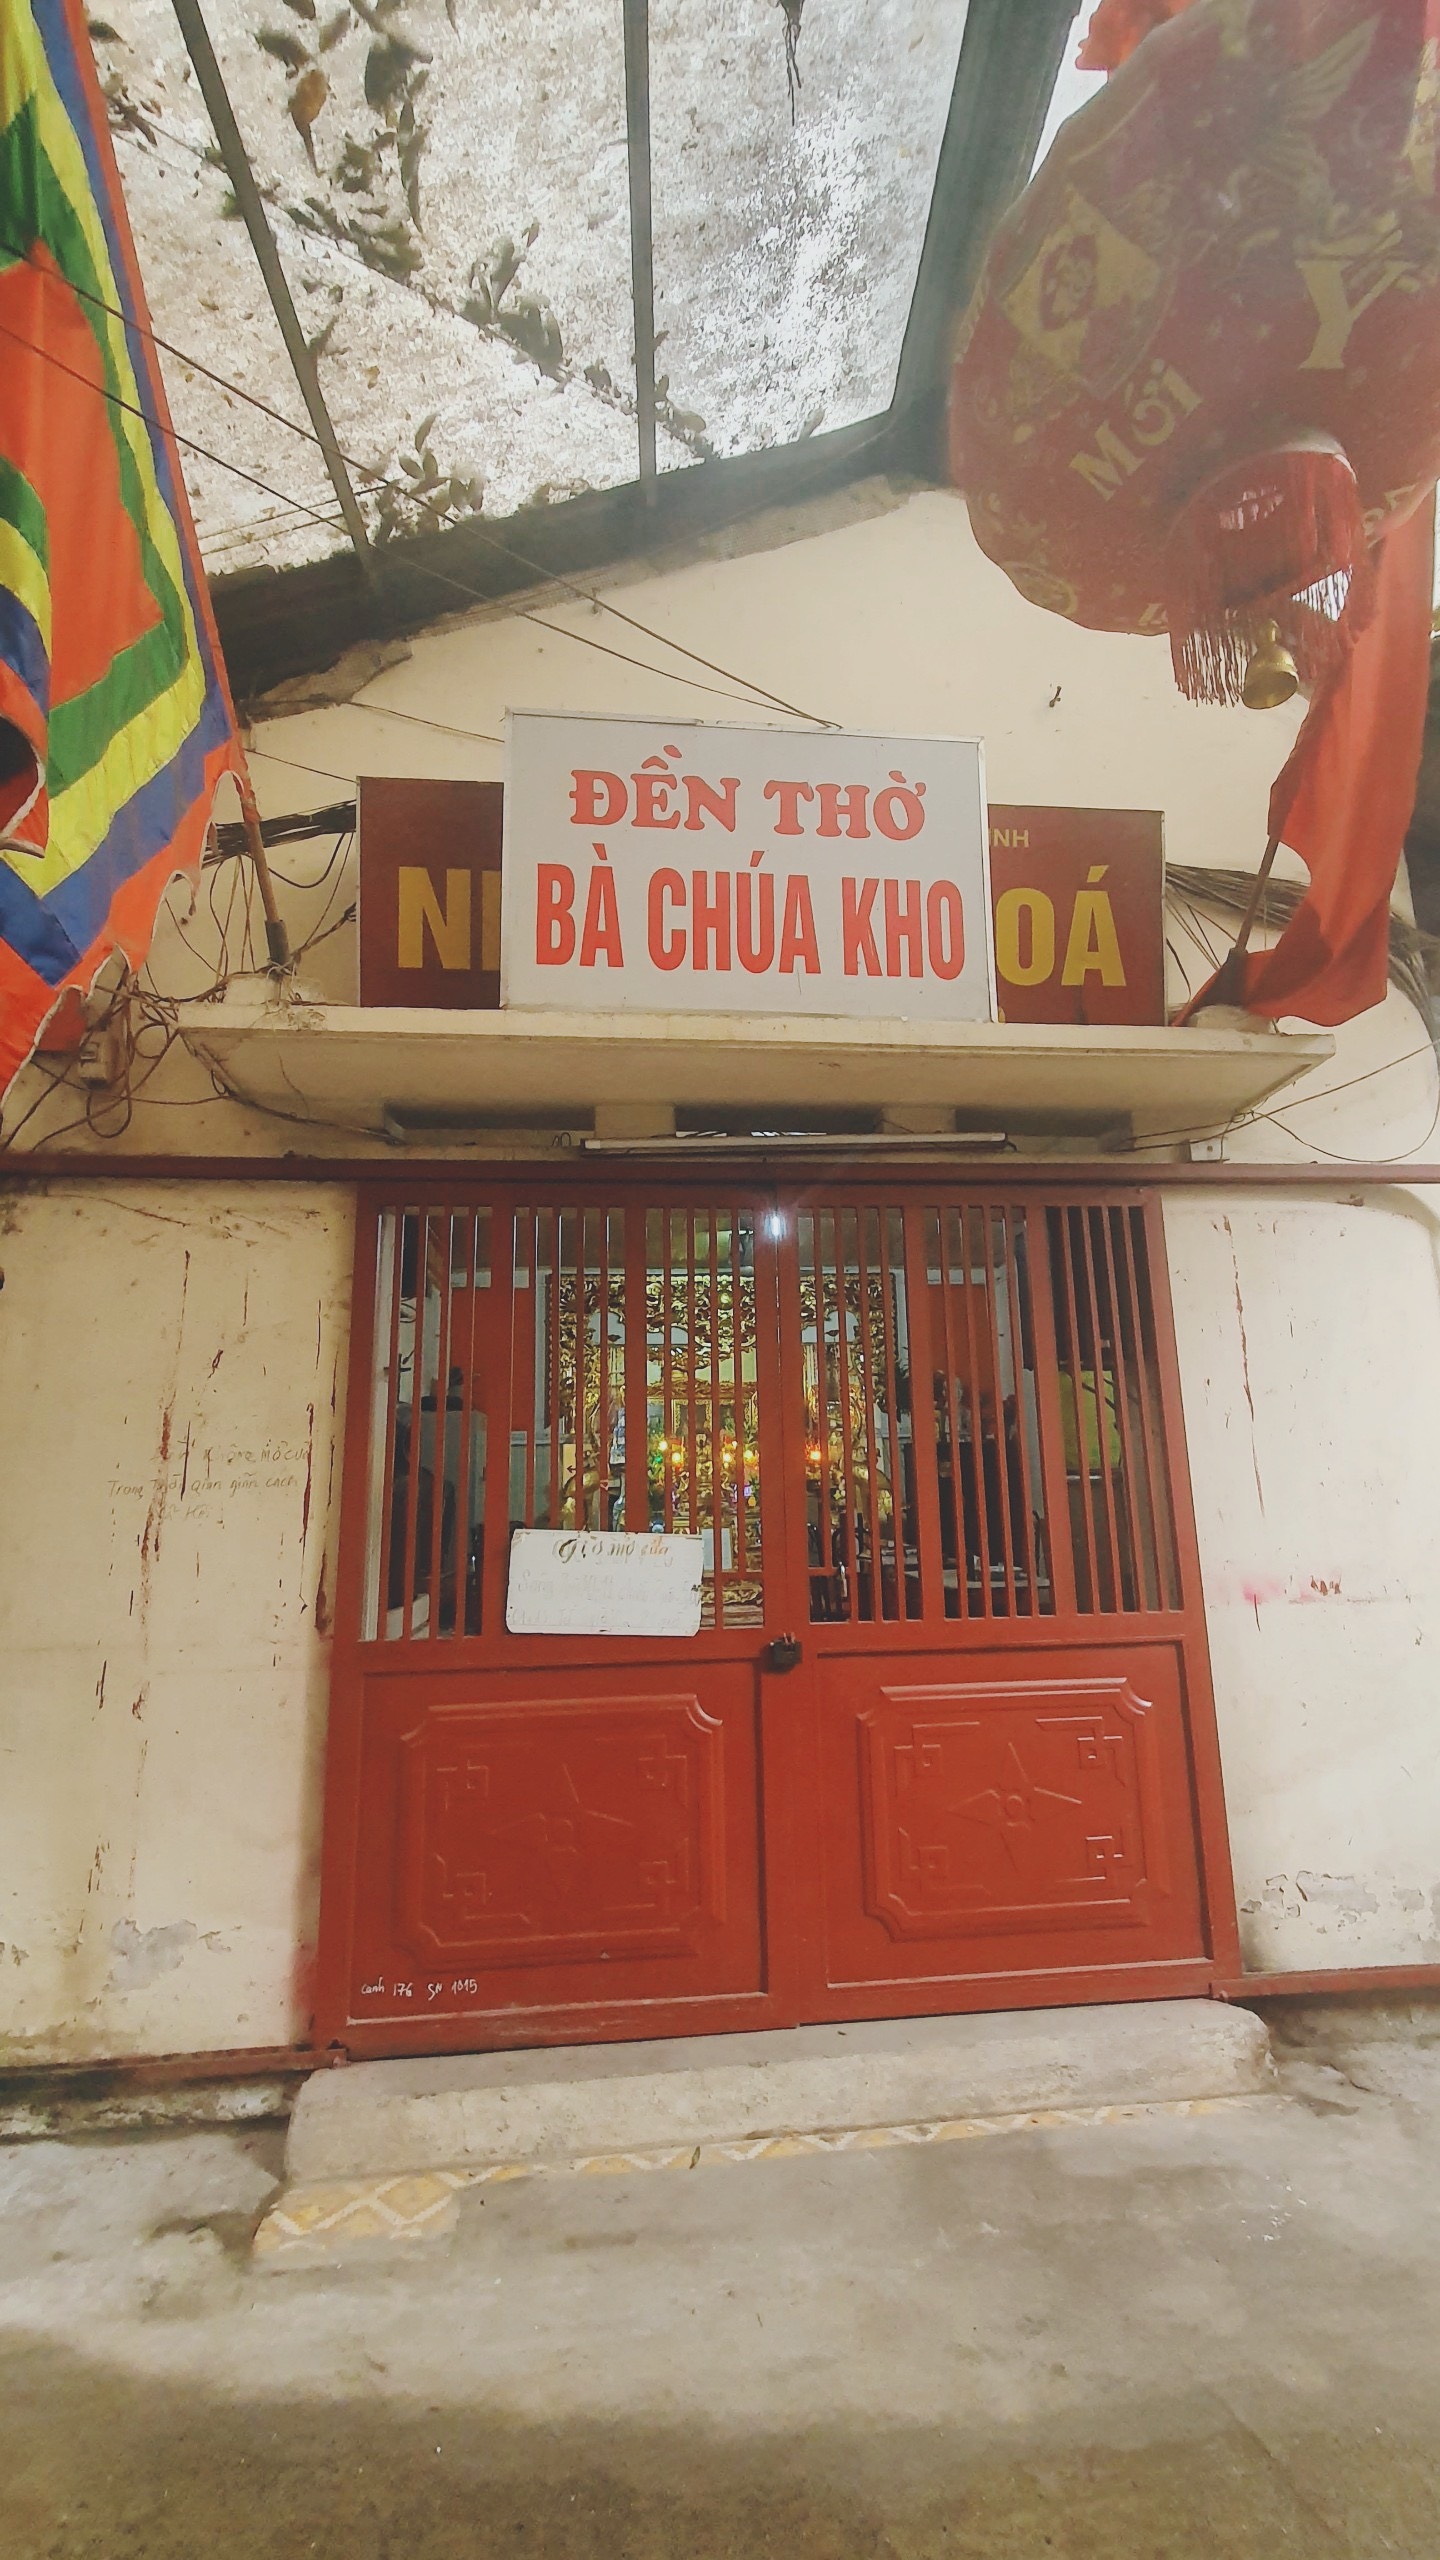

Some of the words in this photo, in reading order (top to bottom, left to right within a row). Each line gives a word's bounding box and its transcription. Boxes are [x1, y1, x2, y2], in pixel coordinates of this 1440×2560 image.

[568, 744, 741, 833] ĐỀN
[763, 770, 927, 841] THỜ
[537, 843, 625, 968] BÀ
[648, 850, 822, 974] CHÚA
[841, 877, 966, 981] KHO
[995, 864, 1127, 987] OÁ
[393, 1982, 414, 1997] 176
